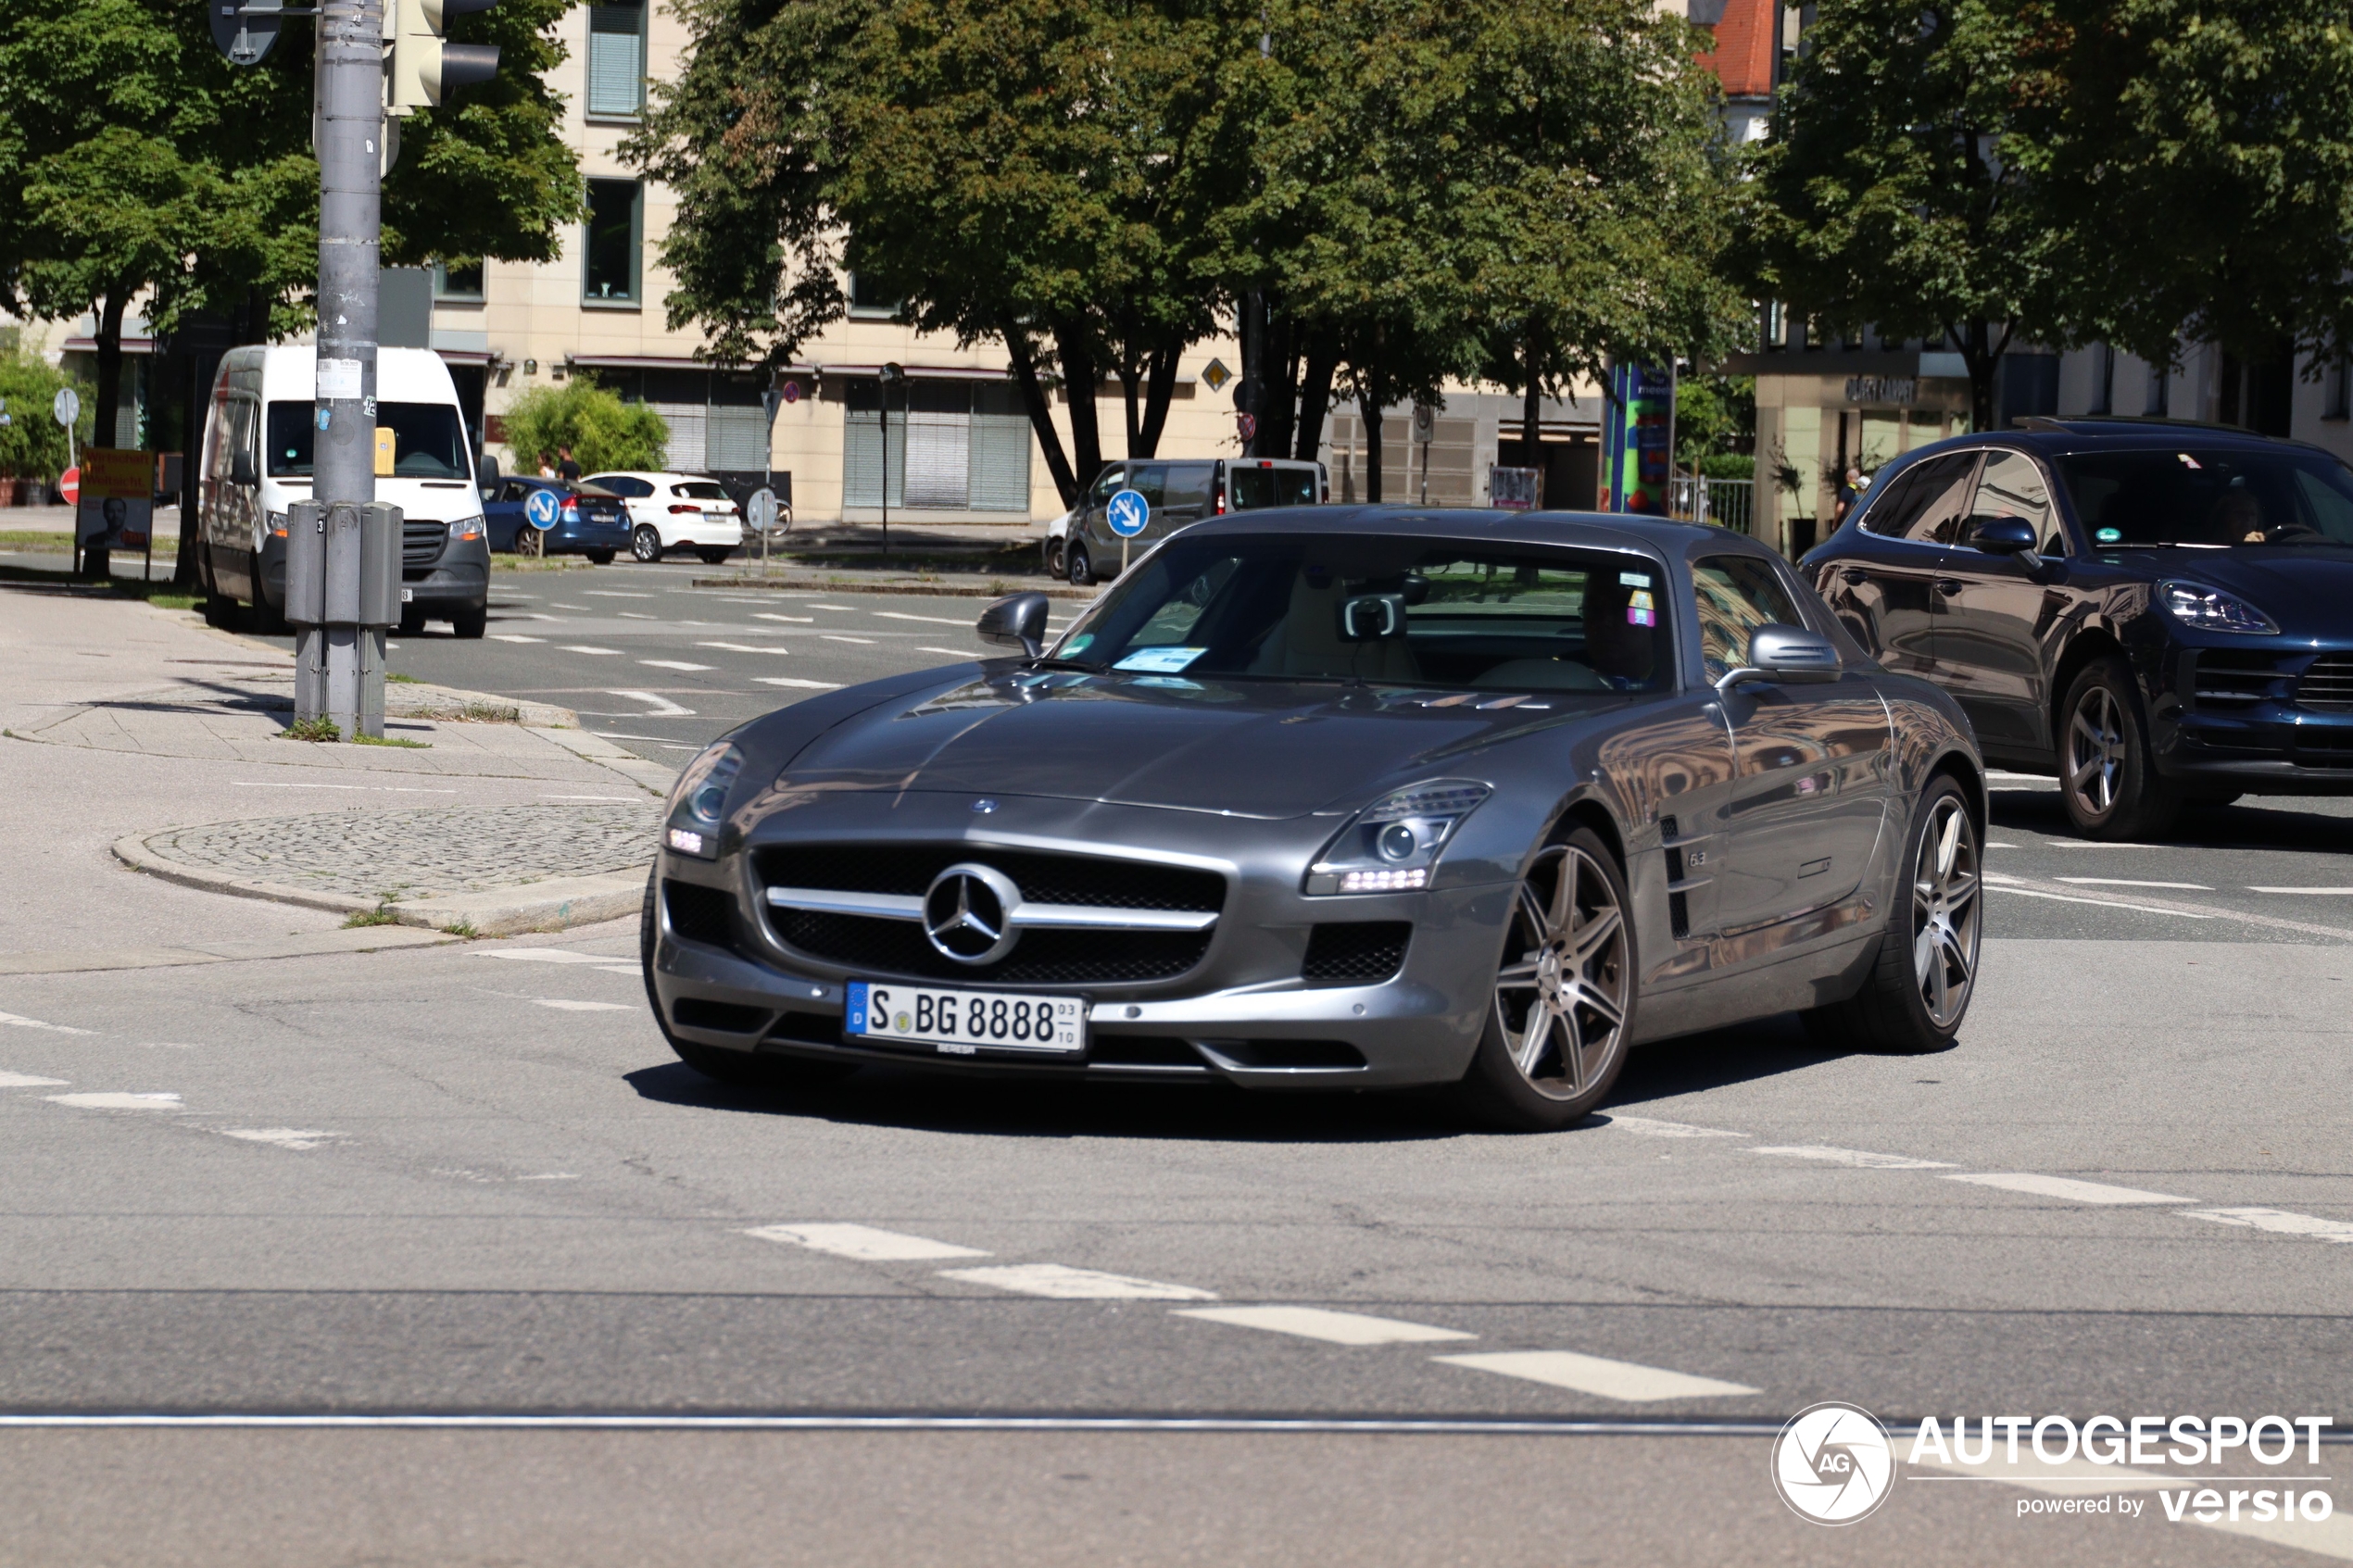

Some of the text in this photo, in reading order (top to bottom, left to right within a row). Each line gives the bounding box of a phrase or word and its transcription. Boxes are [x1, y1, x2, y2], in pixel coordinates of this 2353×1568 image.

[86, 451, 149, 464] Wirtschaft
[318, 520, 323, 533] 3
[871, 990, 1054, 1042] S BG 8888
[1058, 1003, 1075, 1016] 03
[853, 1012, 862, 1024] D
[1058, 1031, 1074, 1044] 10
